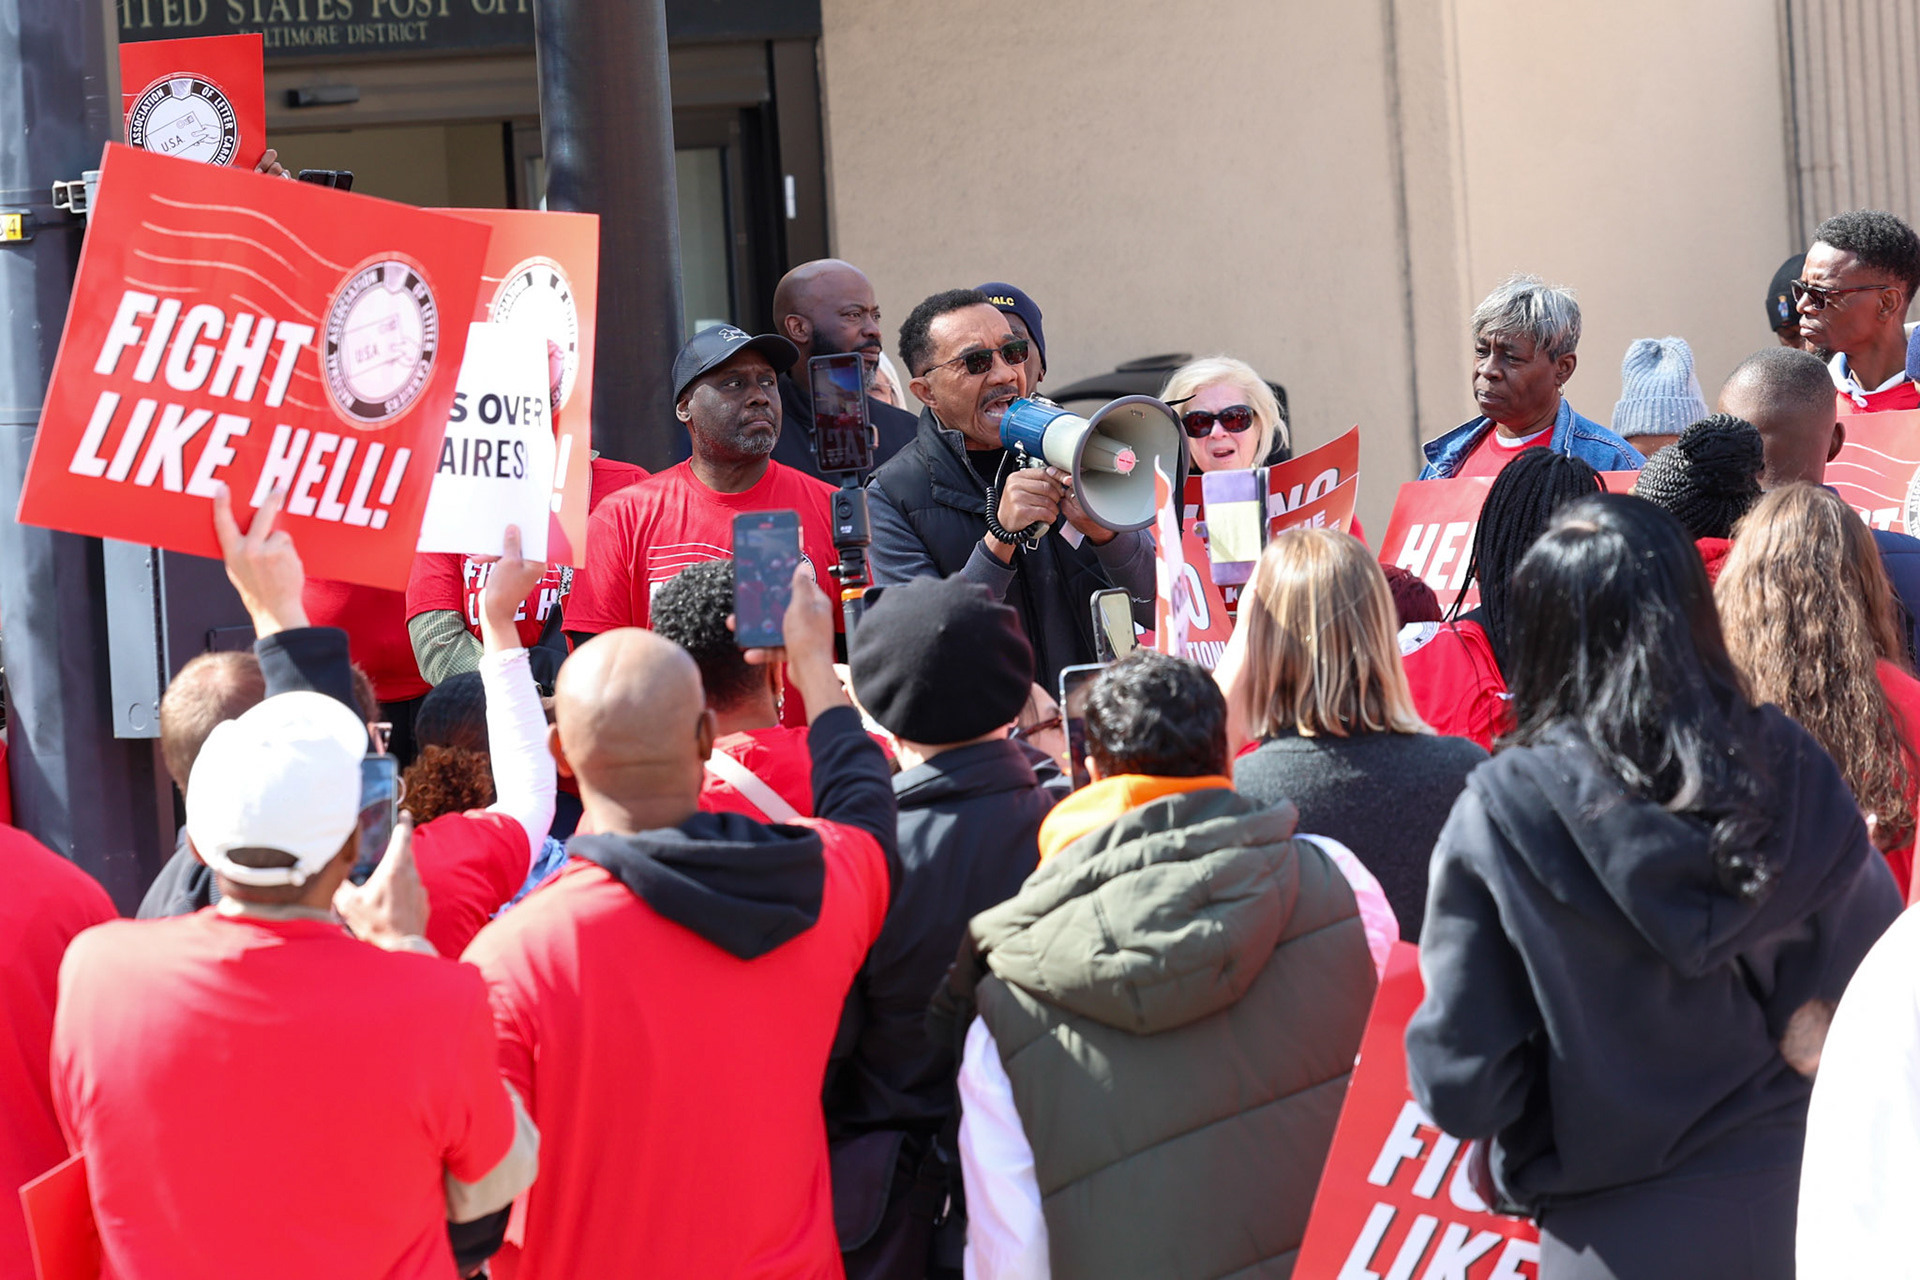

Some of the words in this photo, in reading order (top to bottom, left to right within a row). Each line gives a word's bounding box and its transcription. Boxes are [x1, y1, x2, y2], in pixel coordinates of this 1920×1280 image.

[239, 26, 339, 47] LTIMORE
[348, 21, 428, 45] DISTRICT
[201, 86, 215, 99] OF
[132, 88, 165, 145] ASSOCIATION
[213, 96, 234, 130] LETTER
[213, 135, 234, 167] CARRI
[94, 290, 315, 408] FIGHT
[478, 393, 543, 426] OVER
[68, 391, 250, 499] LIKE
[250, 424, 412, 530] HELL!
